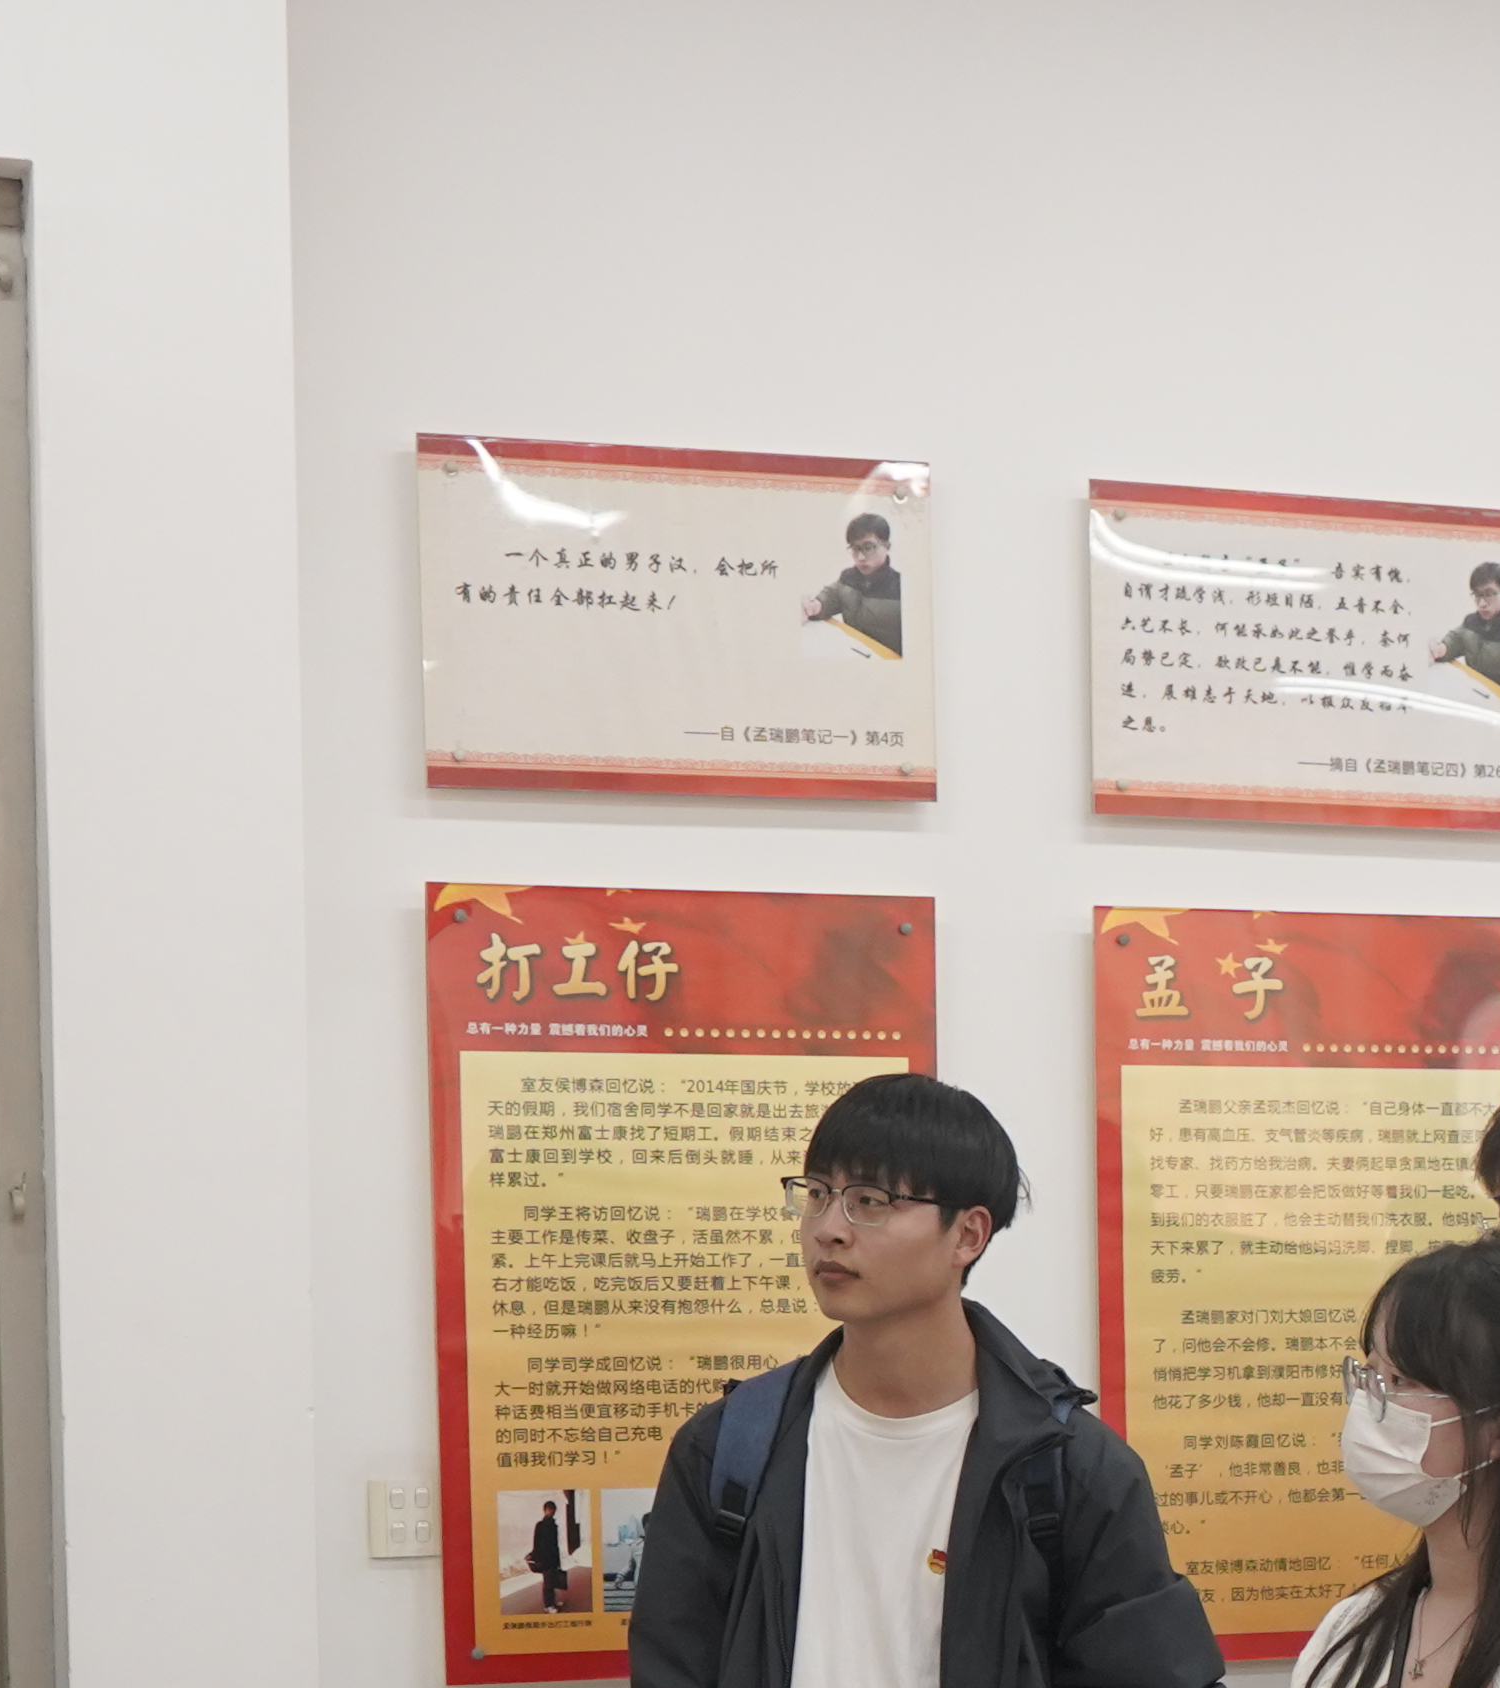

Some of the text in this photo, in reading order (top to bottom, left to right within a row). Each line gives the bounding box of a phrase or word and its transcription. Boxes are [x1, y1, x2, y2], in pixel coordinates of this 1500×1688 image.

[476, 933, 679, 1002] 打工仔
[1135, 955, 1284, 1021] 孟子
[466, 1021, 649, 1039] 总有一种力量 震撼着我们的心灵
[1128, 1037, 1195, 1052] 总有一种力量
[520, 1077, 858, 1097] 室友侯博森回忆说：“2014年国庆节，学校放
[489, 1147, 806, 1166] 富士康回到学校，回来后倒头就睡，从来
[1152, 1391, 1348, 1410] 他花了多少钱，他却一直没有
[1155, 1486, 1366, 1507] 过的事儿或不开心，他都会第一
